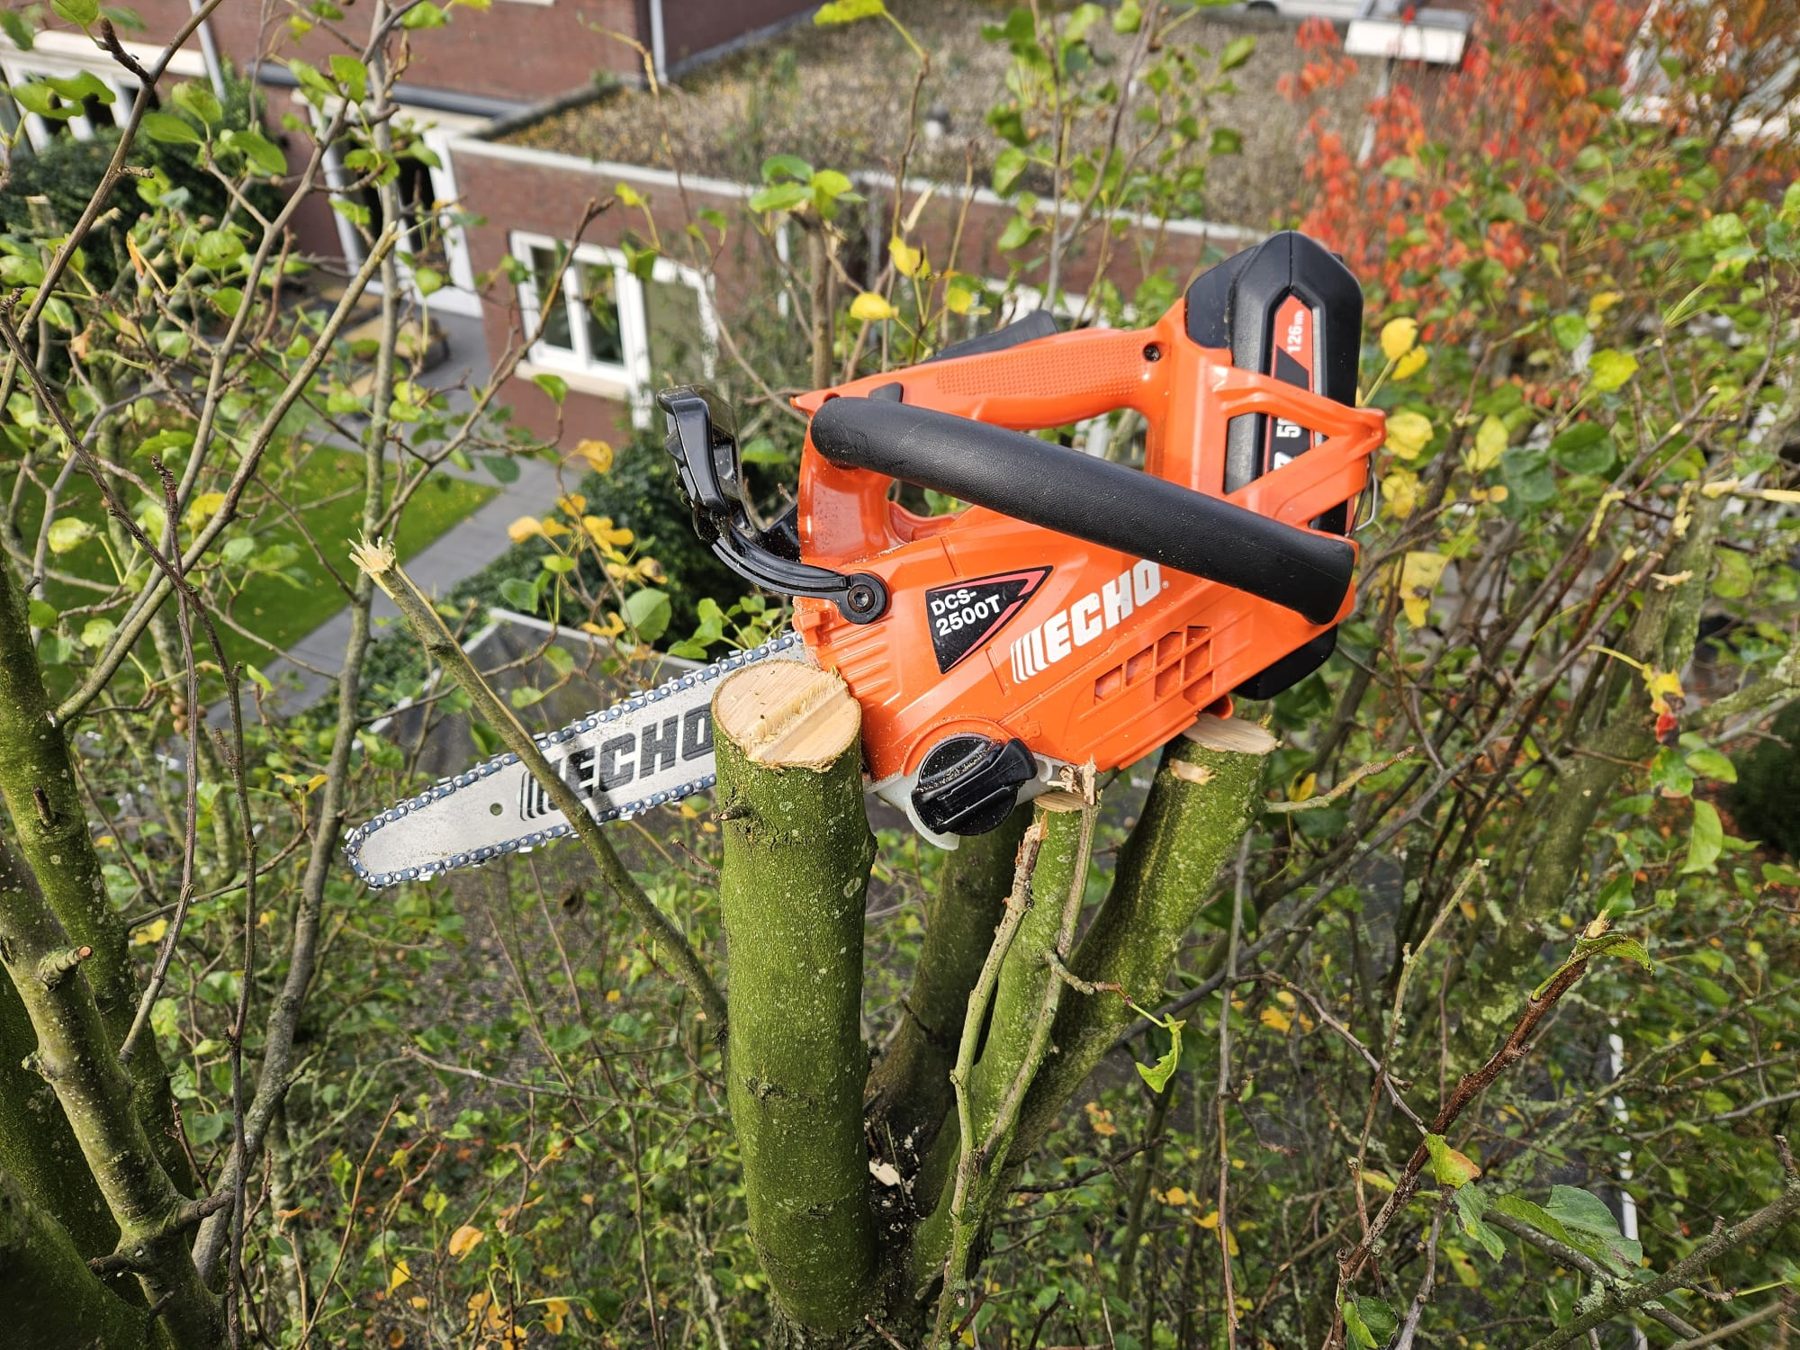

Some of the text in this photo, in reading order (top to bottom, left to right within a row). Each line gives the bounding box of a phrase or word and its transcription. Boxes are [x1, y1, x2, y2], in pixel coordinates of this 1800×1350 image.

[930, 589, 977, 616] DCS-
[935, 594, 1000, 637] 2500T
[1043, 559, 1161, 663] ECHO
[565, 703, 716, 798] ECHO
